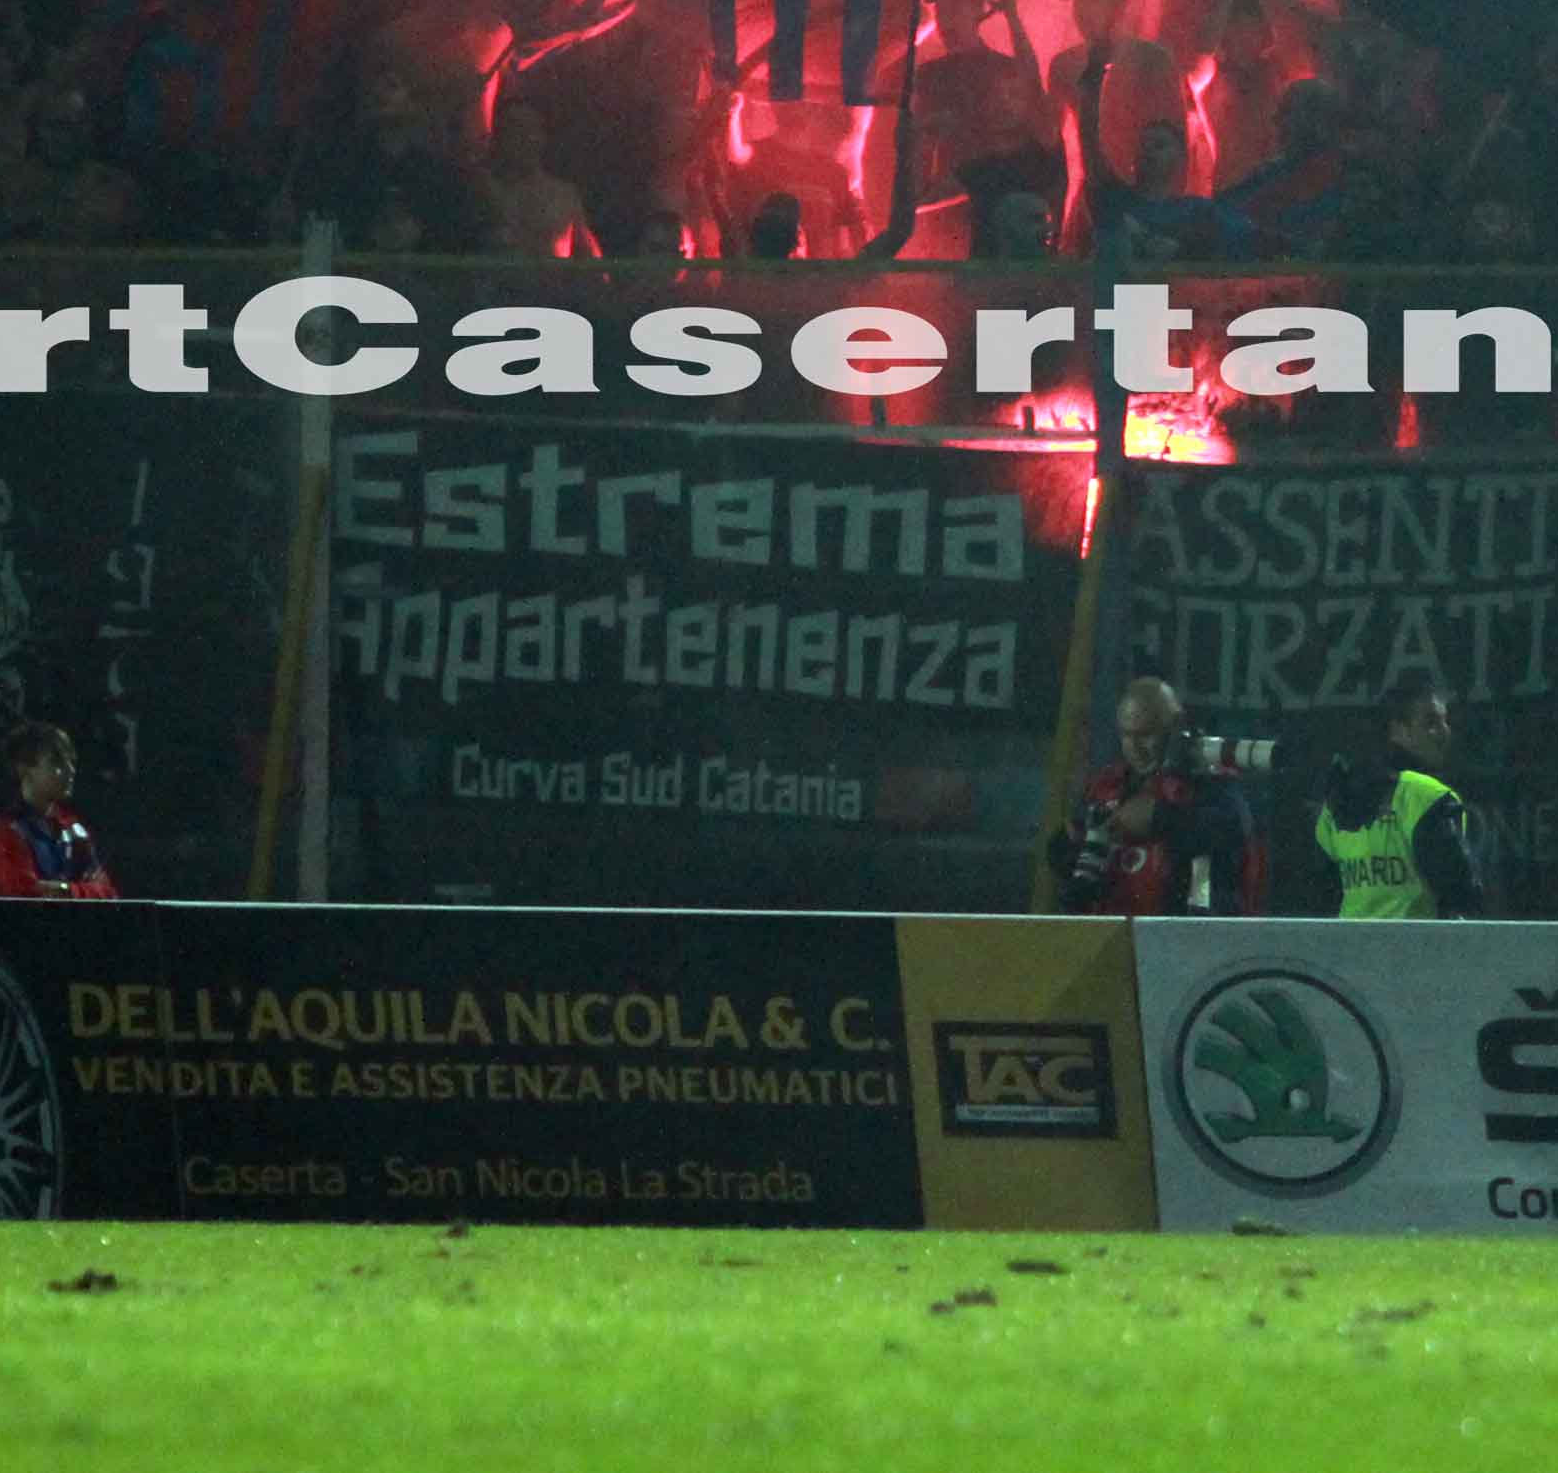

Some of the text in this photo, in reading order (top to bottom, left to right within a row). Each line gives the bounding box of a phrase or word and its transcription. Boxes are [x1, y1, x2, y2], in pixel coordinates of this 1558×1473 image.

[333, 432, 1025, 582] Estrema
[333, 560, 1017, 710] Appartenenza
[452, 742, 862, 823] Curva Sud Catania
[67, 982, 895, 1053] DELL'AQUILA NICOLA & C.
[78, 1056, 899, 1107] VENDITA E ASSISTENZA PNEUMATICI
[183, 1156, 348, 1197] Caserta
[383, 1157, 462, 1199] San
[476, 1155, 608, 1201] Nicola
[619, 1161, 669, 1201] La
[677, 1159, 814, 1203] Strada
